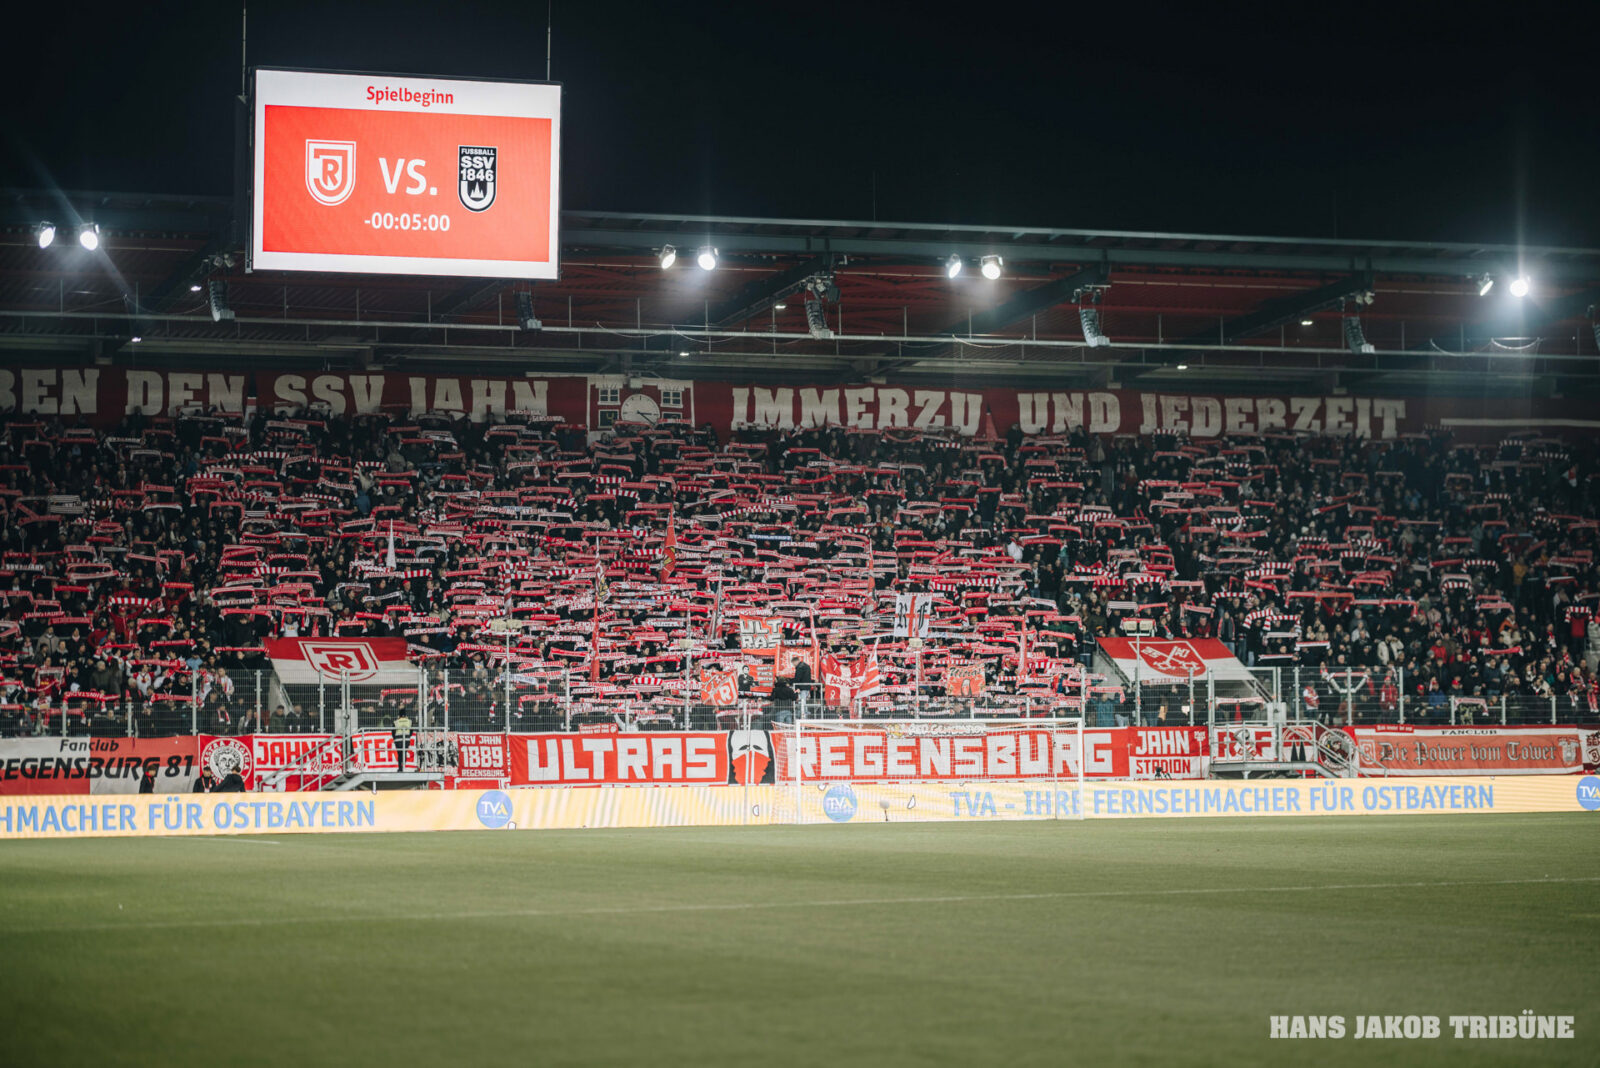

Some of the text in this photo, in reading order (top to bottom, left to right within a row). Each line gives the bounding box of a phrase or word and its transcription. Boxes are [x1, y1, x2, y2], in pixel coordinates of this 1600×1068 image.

[366, 85, 454, 107] Spielbeginn
[461, 148, 495, 156] FUSSBALL
[460, 156, 495, 169] SSV
[378, 157, 438, 196] VS.
[460, 168, 494, 182] 1846
[364, 212, 450, 232] -00:05:00
[125, 369, 245, 418] DEN
[273, 374, 385, 417] SSV
[731, 387, 983, 437] IMMERZU
[1017, 391, 1121, 434] UND
[1139, 392, 1406, 440] JEDERZEIT
[740, 619, 782, 635] ULT
[461, 643, 502, 652] JAHNSTADION
[740, 635, 782, 649] RAS
[60, 739, 119, 752] Fanclub
[459, 735, 476, 744] SSV
[479, 735, 502, 744] JAHN
[1136, 730, 1189, 756] JAHN
[460, 746, 504, 768] 1889
[526, 738, 717, 782] ULTRAS
[786, 732, 1114, 779] REGENSBURG
[1378, 741, 1409, 762] Die
[1413, 741, 1467, 765] Power
[1506, 741, 1556, 761] Tower
[164, 755, 195, 778] 81
[461, 769, 505, 777] REGENSBURG
[1136, 759, 1191, 774] STADION
[481, 801, 509, 816] TVA
[950, 791, 998, 817] TVA
[1023, 790, 1081, 816] IHRE
[1093, 787, 1301, 814] FERNSEHMACHER
[1310, 780, 1355, 811] FÜR
[1362, 784, 1494, 811] OSTBAYERN
[149, 796, 203, 830] FÜR
[213, 800, 375, 829] OSTBAYERN
